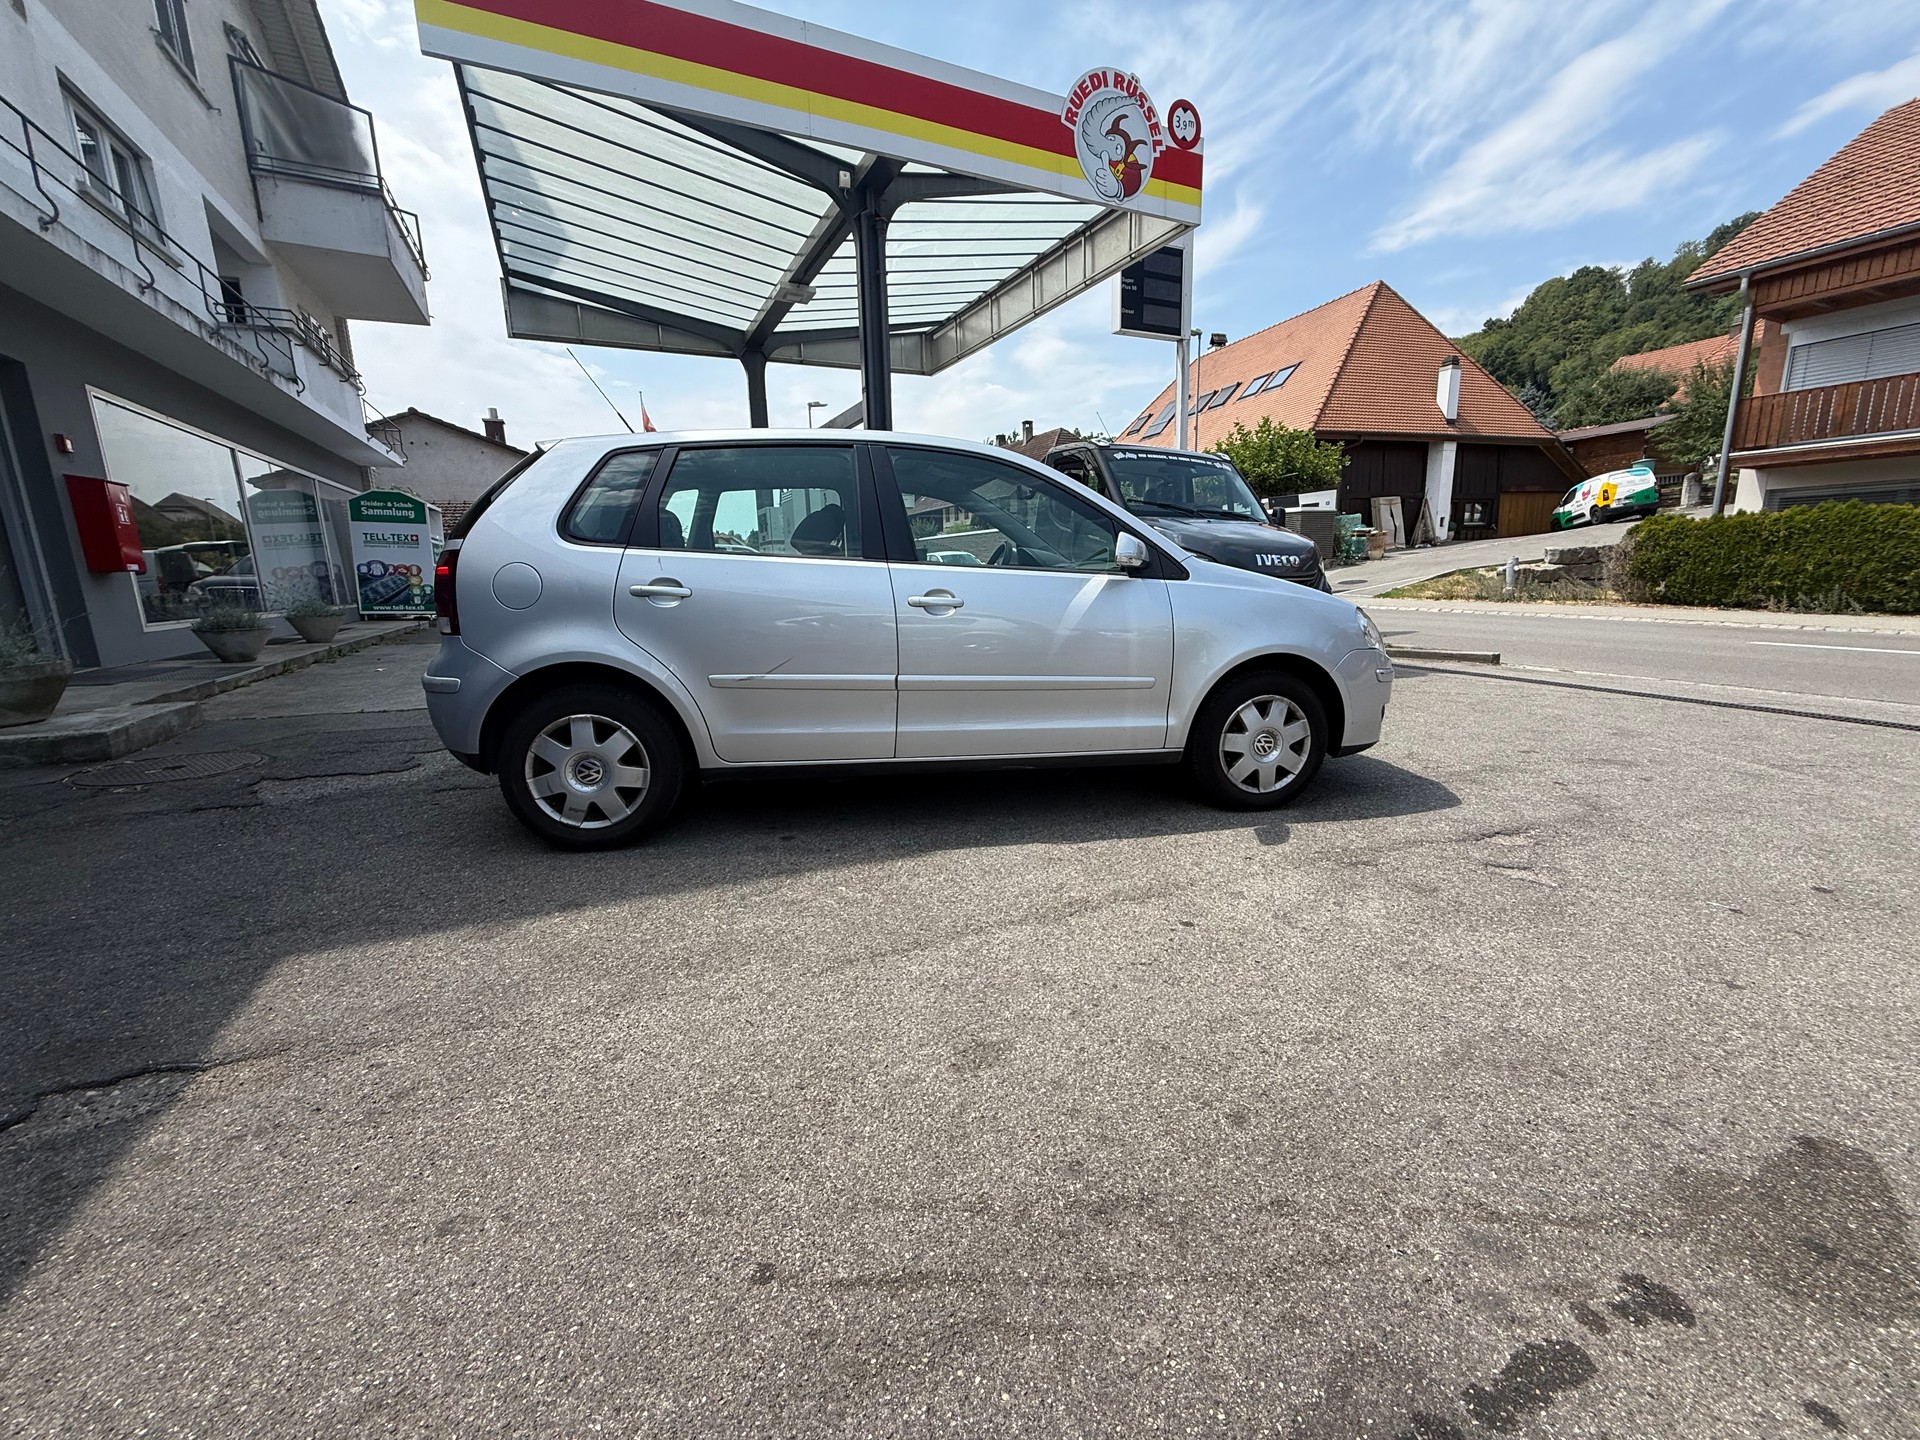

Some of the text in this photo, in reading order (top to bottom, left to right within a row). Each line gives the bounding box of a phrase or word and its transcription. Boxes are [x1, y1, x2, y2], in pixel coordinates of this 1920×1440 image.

[1065, 70, 1163, 153] RUEDI RÜSSEL
[361, 507, 415, 519] Sammlung
[362, 532, 410, 542] TELL-TEX
[1255, 553, 1300, 567] IVECO
